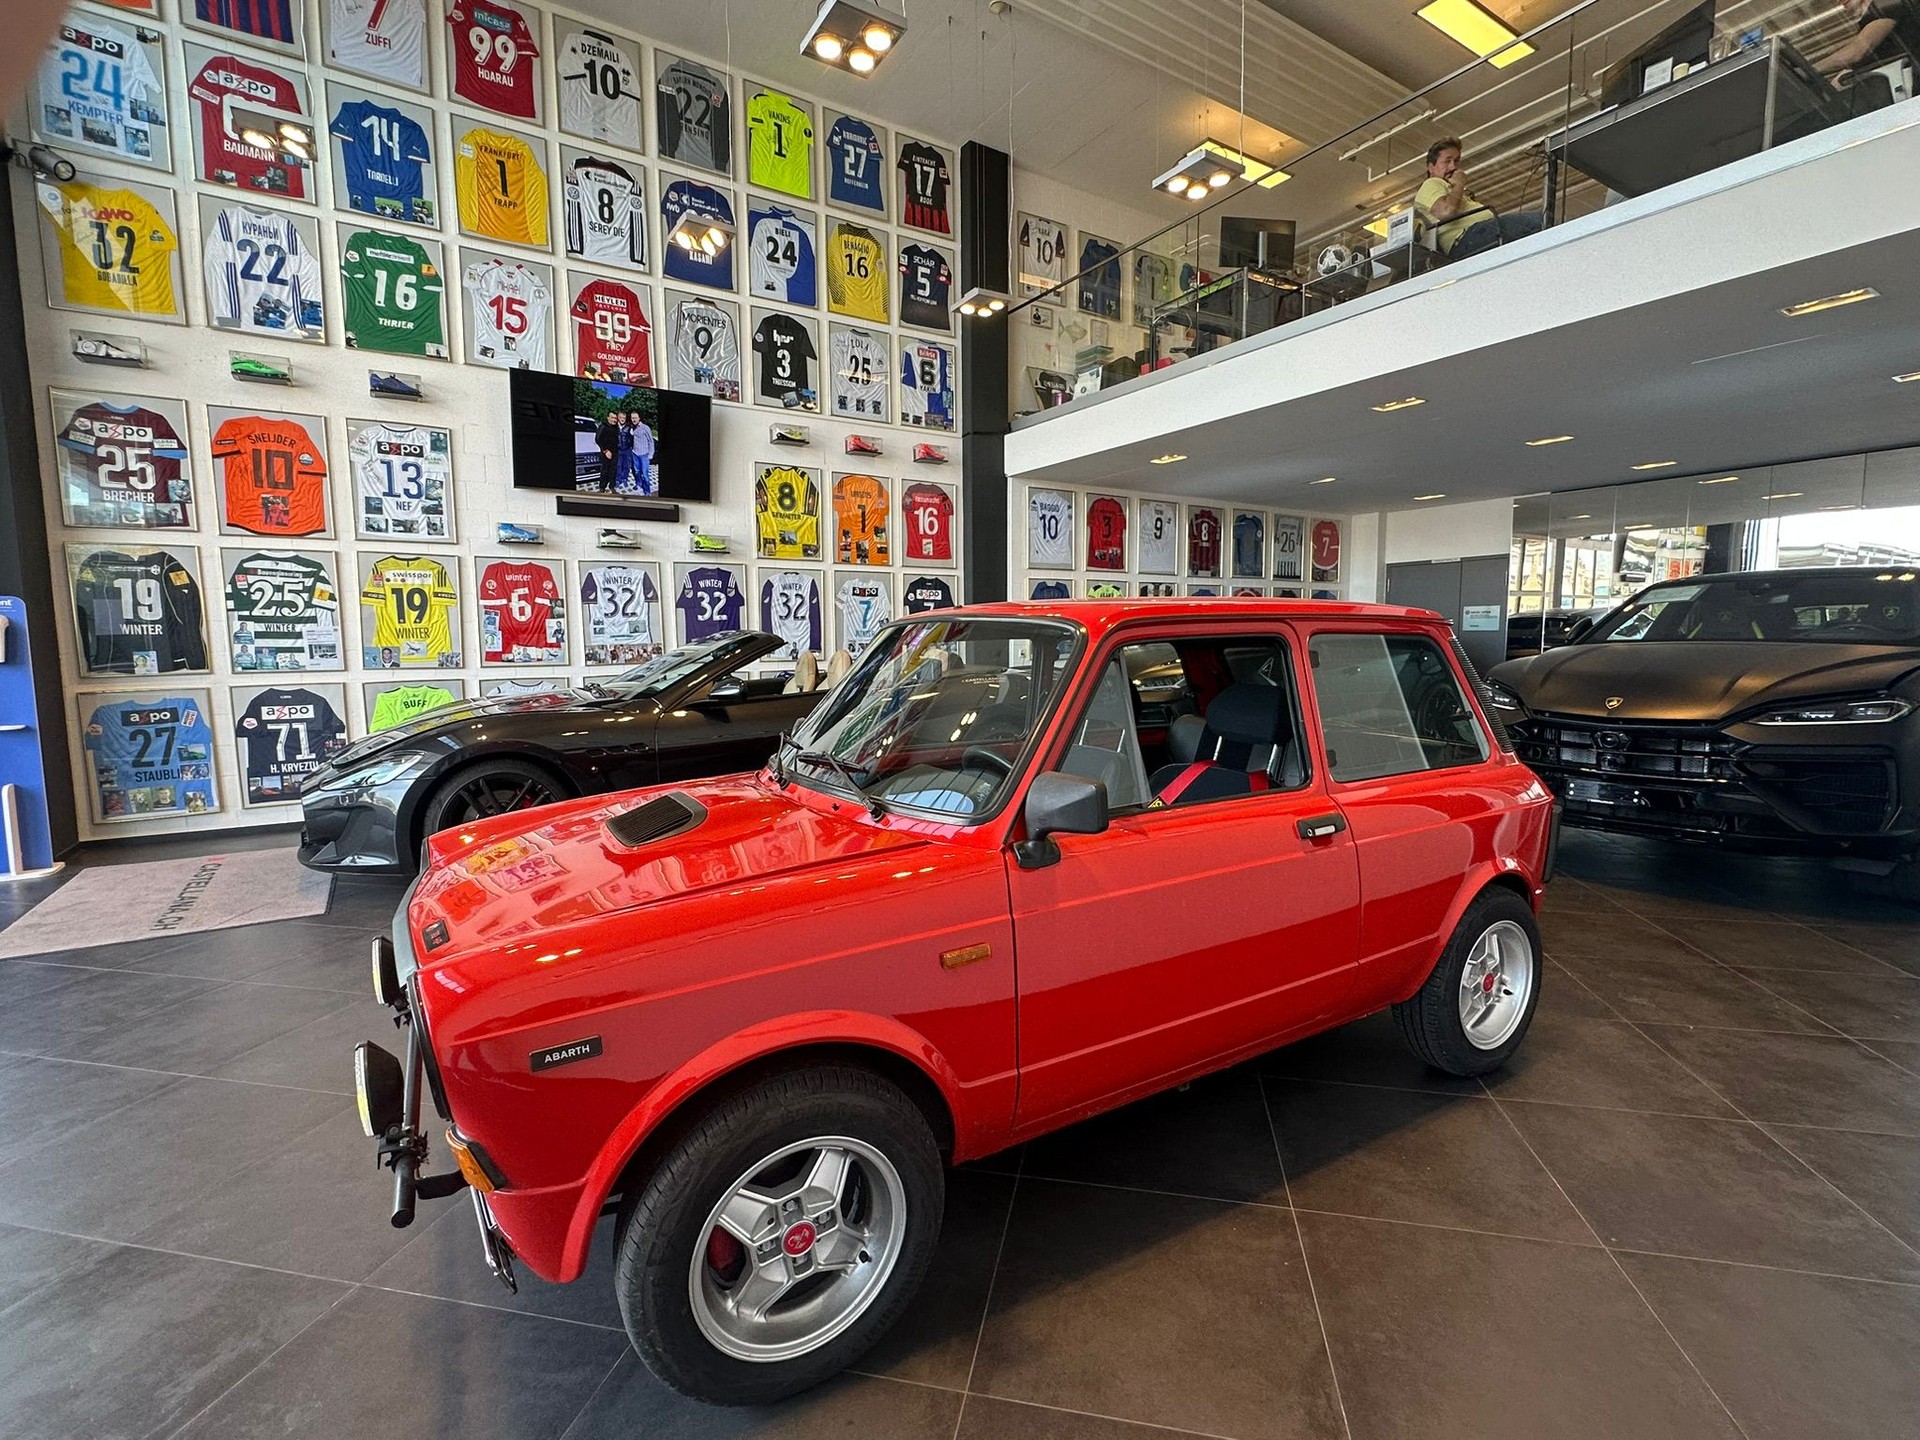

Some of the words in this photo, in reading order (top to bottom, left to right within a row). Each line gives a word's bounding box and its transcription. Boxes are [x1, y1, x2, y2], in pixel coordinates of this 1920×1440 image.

[365, 32, 391, 50] ZUFFI
[469, 26, 518, 74] 99
[60, 49, 125, 111] 24
[478, 66, 514, 87] HOARAU
[584, 59, 621, 100] 10
[67, 99, 125, 126] KEMPTER
[676, 86, 710, 129] 22
[223, 139, 276, 162] BAUMANN
[361, 115, 400, 162] 14
[480, 145, 520, 160] FRANKFURT
[774, 122, 787, 159] 1
[843, 143, 867, 178] 27
[496, 158, 510, 198] 1
[914, 163, 936, 198] 17
[494, 198, 518, 210] TRAPP
[598, 188, 614, 224] 8
[588, 221, 612, 237] SEREY
[237, 238, 289, 287] 22
[766, 236, 798, 268] 24
[1036, 237, 1053, 265] 10
[844, 253, 869, 279] 16
[374, 269, 418, 311] 16
[917, 265, 930, 298] 5
[488, 294, 528, 334] 15
[594, 294, 627, 307] HEYLEN
[378, 317, 415, 330] THRIER
[594, 309, 631, 343] 99
[682, 311, 727, 329] MORIENTES
[605, 341, 625, 352] FREY
[694, 326, 713, 360] 9
[776, 349, 791, 378] 3
[848, 354, 871, 386] 25
[920, 359, 935, 387] 6
[98, 423, 148, 439] axpo
[248, 432, 296, 449] SNEIJDER
[380, 441, 421, 455] axpo
[96, 444, 157, 491] 25
[252, 447, 294, 490] 10
[380, 459, 424, 500] 13
[103, 489, 155, 504] BRECHER
[396, 501, 413, 511] NEF
[777, 481, 797, 512] 8
[857, 504, 866, 533] 1
[913, 506, 939, 536] 16
[1039, 513, 1058, 540] 10
[1102, 515, 1111, 539] 3
[1154, 517, 1163, 540] 9
[1201, 522, 1209, 541] 8
[1280, 531, 1295, 553] 26
[1322, 537, 1329, 557] 7
[505, 573, 532, 582] winter
[605, 576, 632, 586] WINTER
[698, 579, 722, 589] WINTER
[781, 581, 803, 592] WINTER
[113, 577, 164, 621] 19
[249, 579, 306, 617] 25
[390, 587, 429, 624] 19
[509, 587, 532, 622] 6
[602, 587, 638, 618] 32
[696, 590, 728, 621] 32
[778, 592, 807, 621] 32
[264, 623, 297, 633] WINTER
[859, 600, 872, 629] 7
[120, 624, 163, 636] WINTER
[394, 627, 431, 639] WINTER
[129, 710, 171, 724] axpo
[266, 704, 310, 718] axpo
[403, 698, 427, 709] BUFF
[128, 725, 177, 768] 27
[267, 722, 316, 762] 71
[270, 763, 280, 774] H.
[543, 1044, 591, 1063] ABARTH
